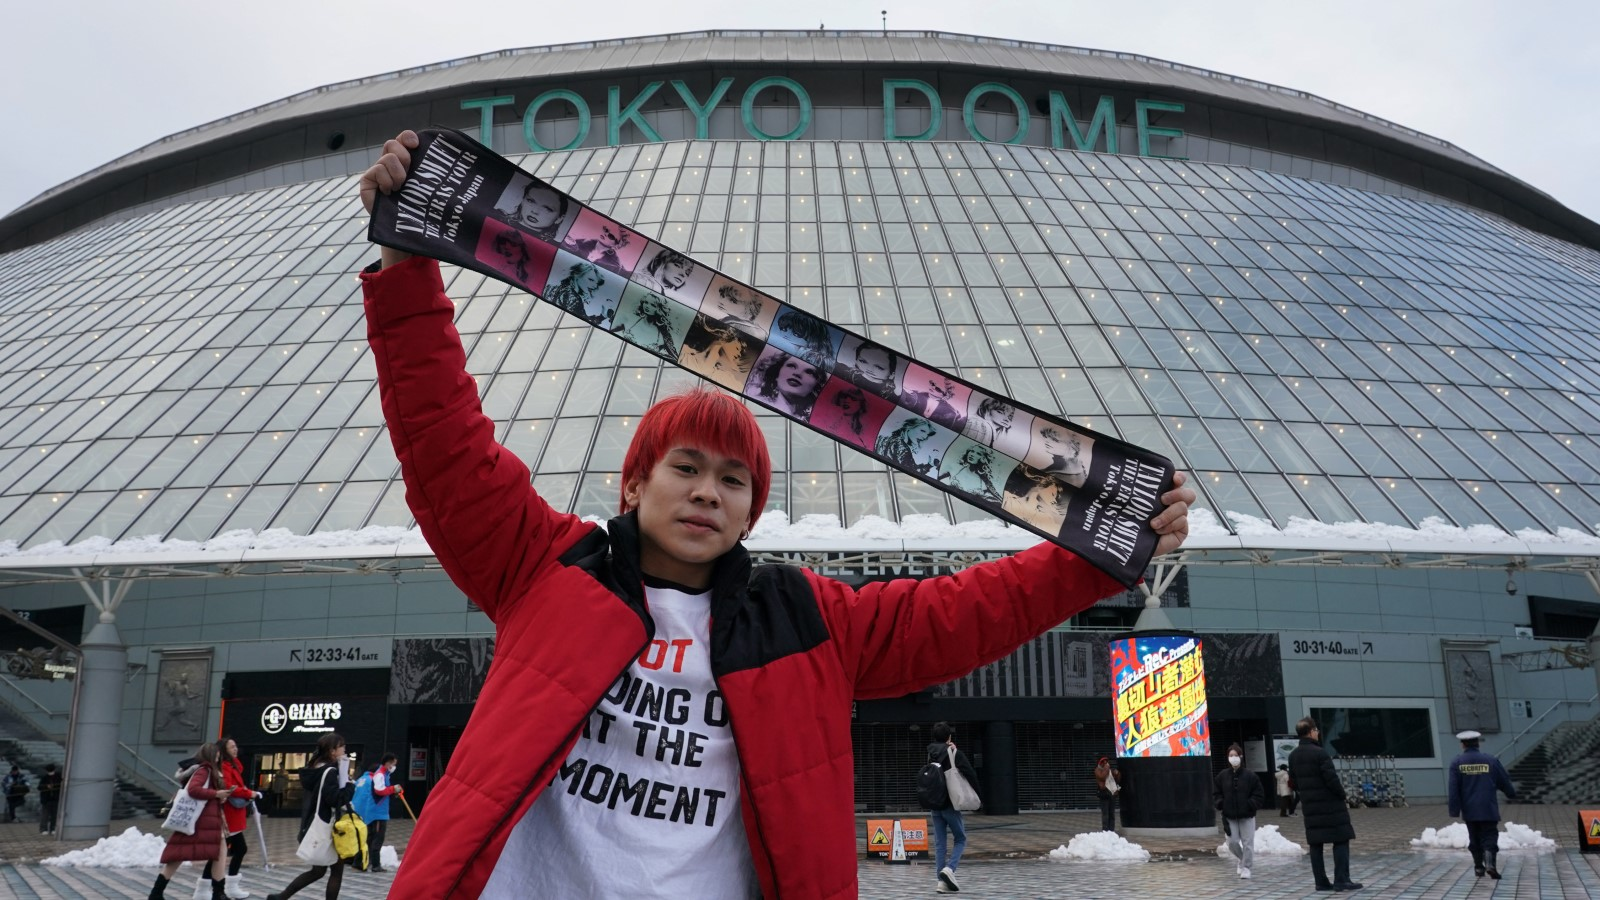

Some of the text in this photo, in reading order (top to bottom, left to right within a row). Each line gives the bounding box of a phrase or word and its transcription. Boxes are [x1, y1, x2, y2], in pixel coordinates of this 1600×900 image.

[461, 76, 1189, 160] TOKYO DOME
[395, 133, 462, 234] TAYLOR SWIFT
[425, 151, 478, 239] THE ERAS TOUR
[443, 174, 485, 242] Tokyo Japan
[1082, 464, 1121, 532] Tokyo Japan
[1093, 458, 1139, 551] THE ERAS TOUR
[1106, 462, 1166, 566] TAYLOR SWIFT
[863, 552, 924, 575] LIVE
[361, 653, 379, 661] GATE
[637, 639, 693, 673] OT
[288, 702, 342, 720] GIANTS
[633, 720, 709, 768] THE
[547, 757, 726, 827] MOMENT
